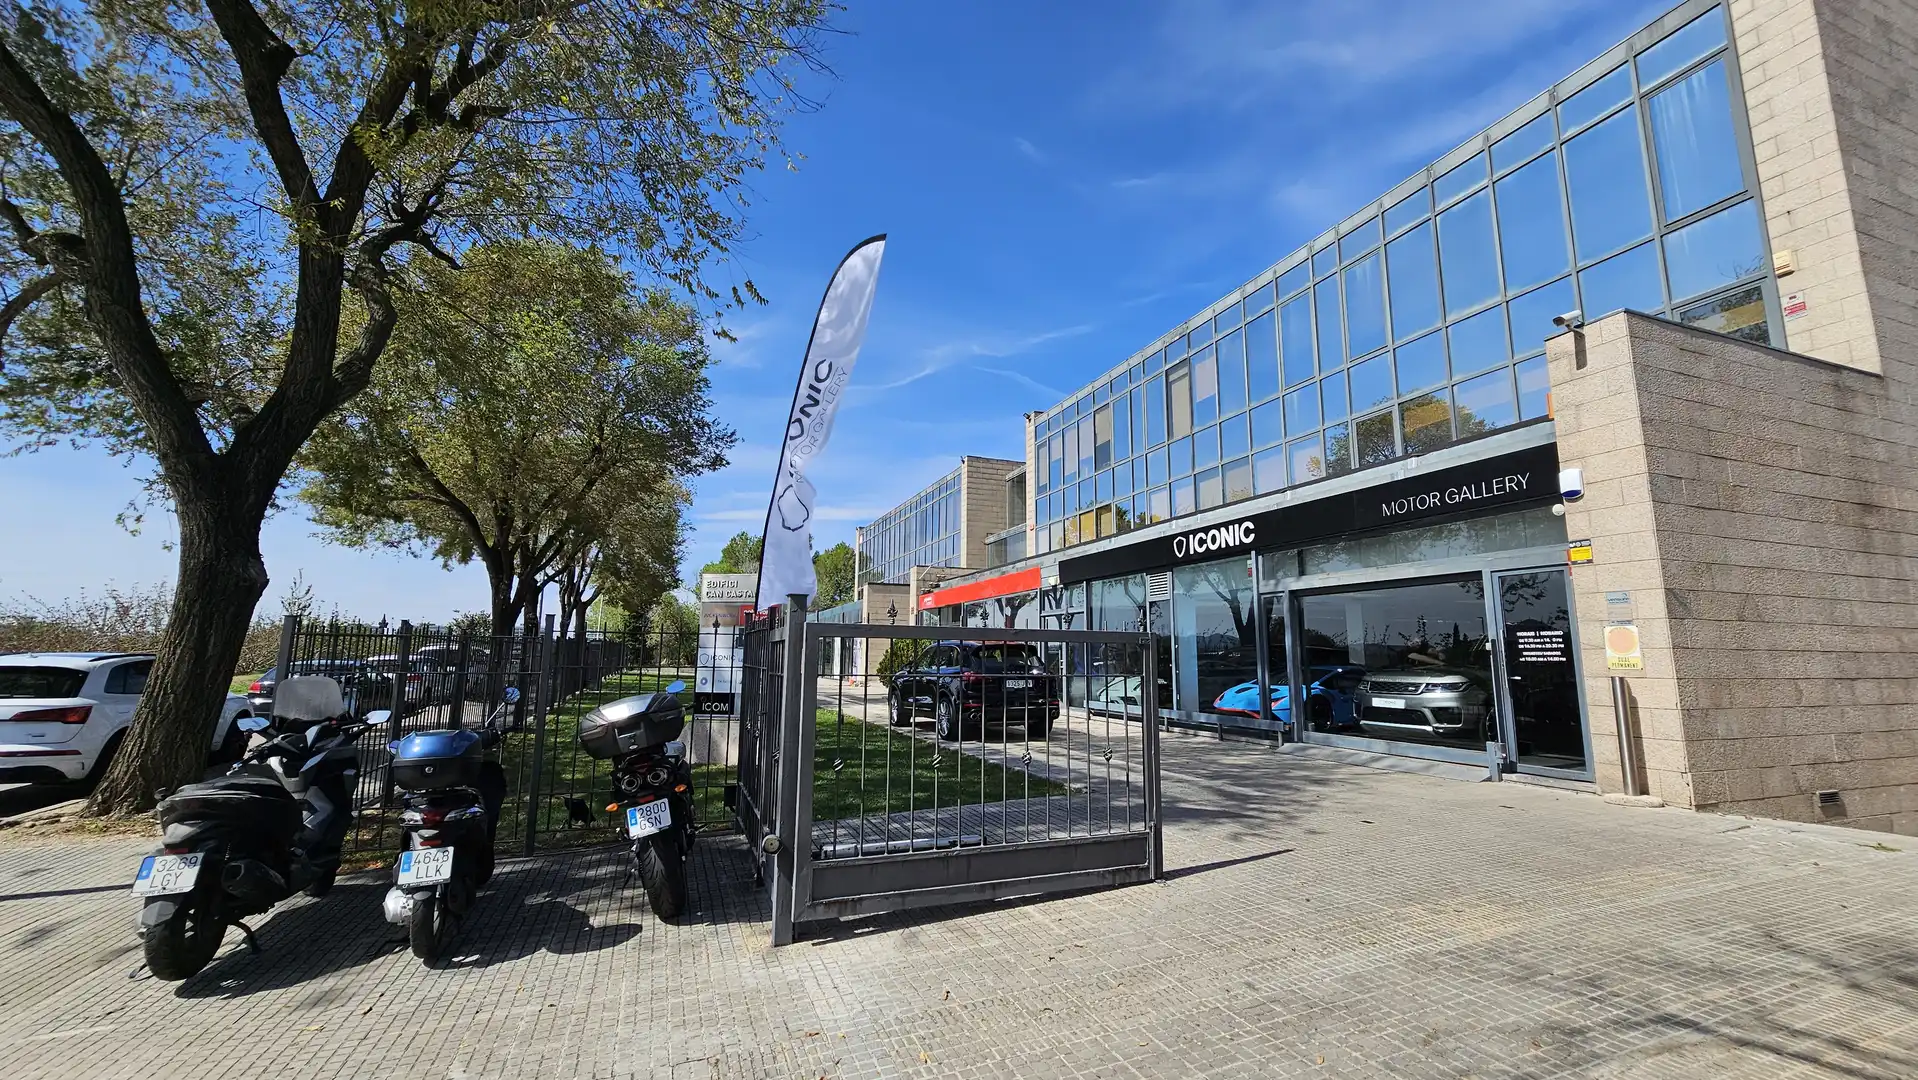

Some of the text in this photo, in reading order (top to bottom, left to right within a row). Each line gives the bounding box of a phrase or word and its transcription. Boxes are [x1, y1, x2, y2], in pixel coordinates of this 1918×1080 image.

[1382, 472, 1531, 518] MOTOR GALLERY
[1189, 521, 1256, 555] ICONIC
[706, 580, 739, 589] EDIFICI
[706, 590, 724, 599] CAN
[702, 702, 729, 712] ICOM
[638, 802, 667, 819] 2800
[640, 814, 662, 831] GSN
[157, 856, 199, 873] 3269
[413, 850, 450, 867] 4648
[416, 864, 444, 879] LLK
[150, 872, 183, 889] LGY
